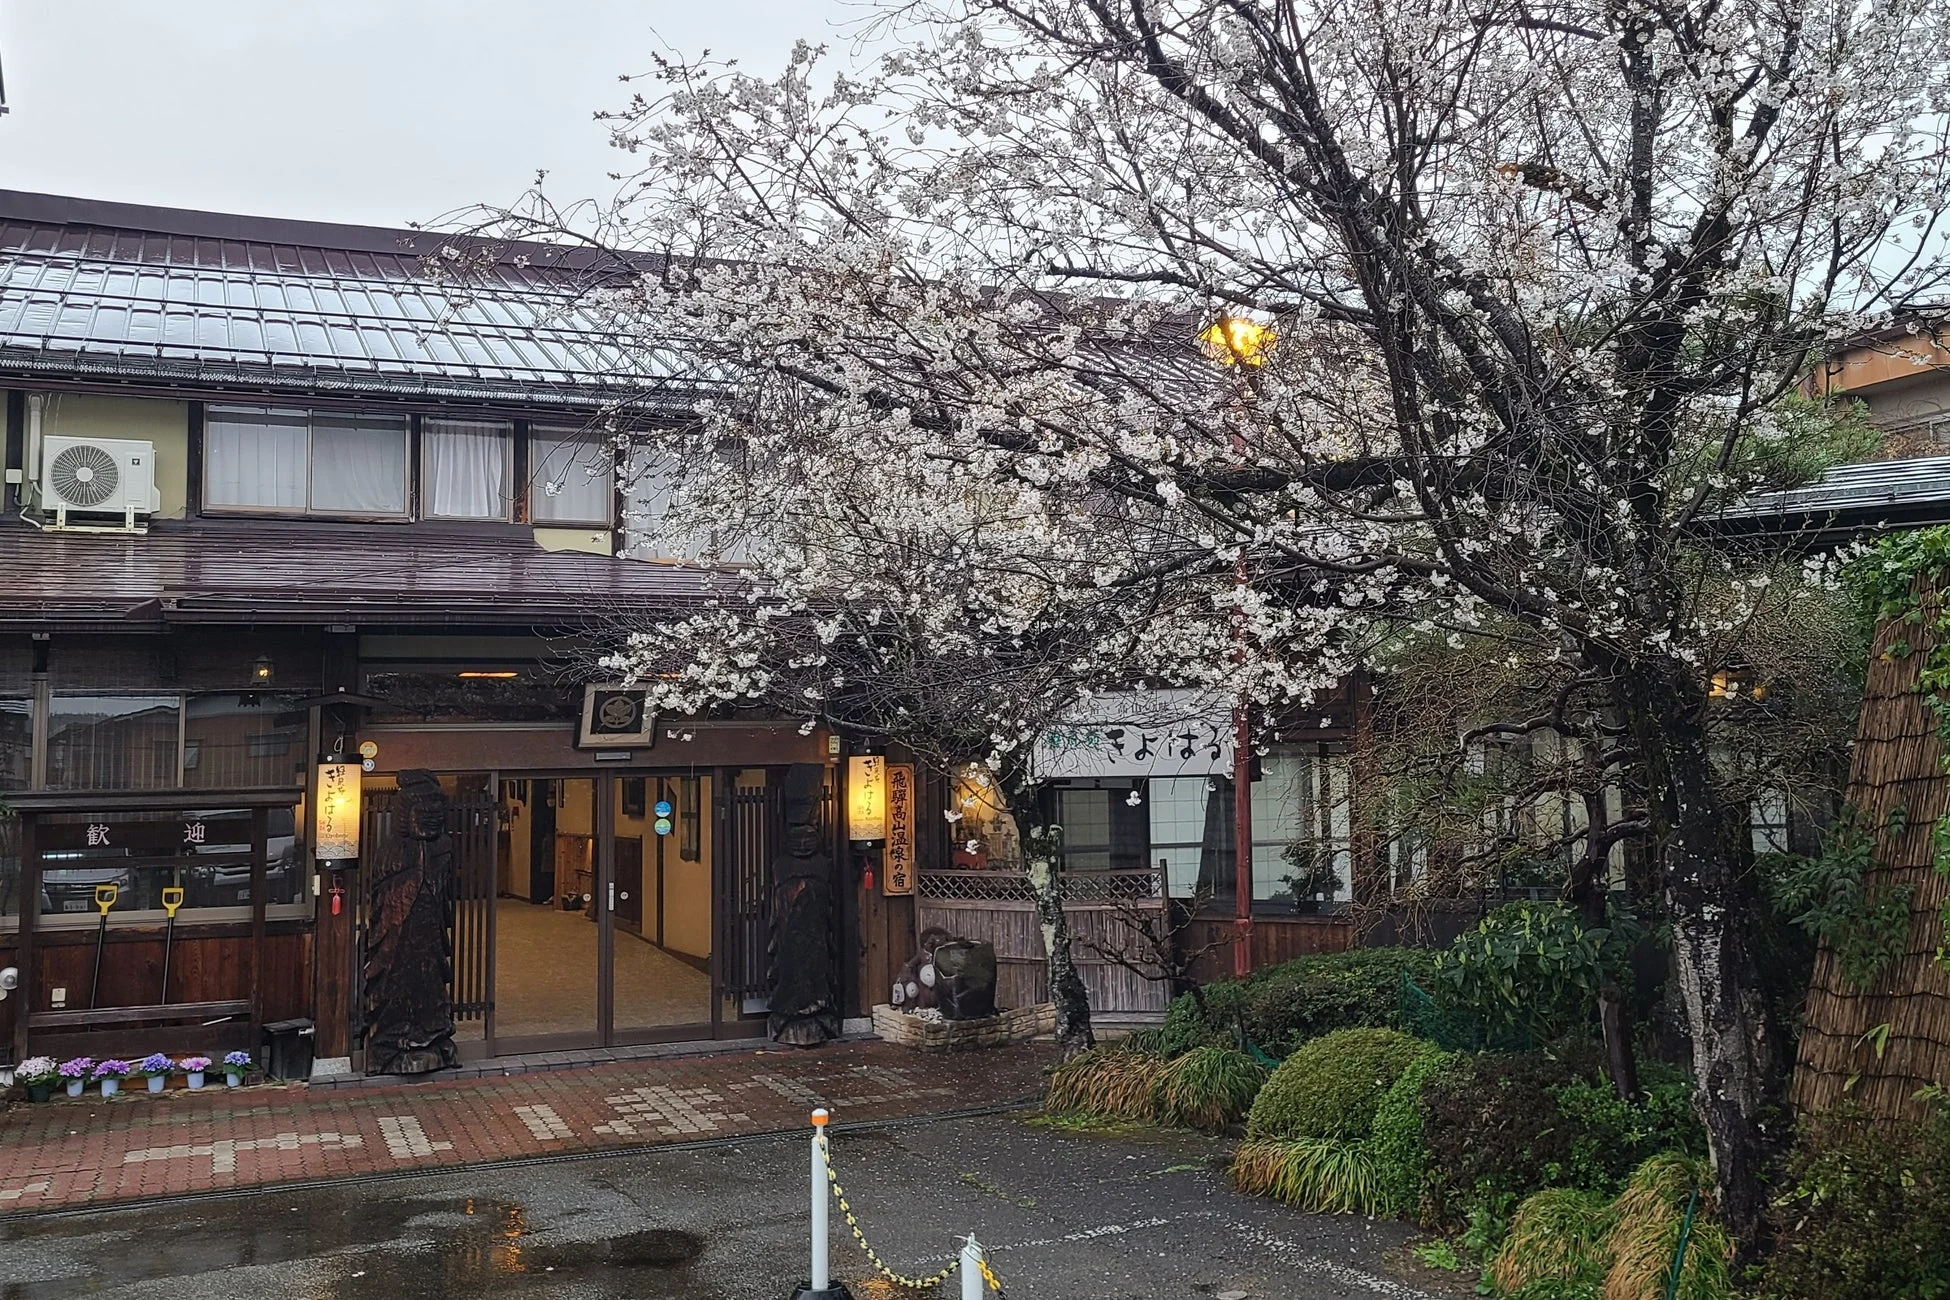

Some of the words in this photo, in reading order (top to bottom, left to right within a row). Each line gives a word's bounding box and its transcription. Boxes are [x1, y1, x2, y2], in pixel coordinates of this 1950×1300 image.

[1104, 725, 1222, 764] きよはる
[325, 769, 336, 833] きよはる
[863, 759, 874, 816] きよはる
[891, 771, 909, 888] 飛騨高山温泉の宿
